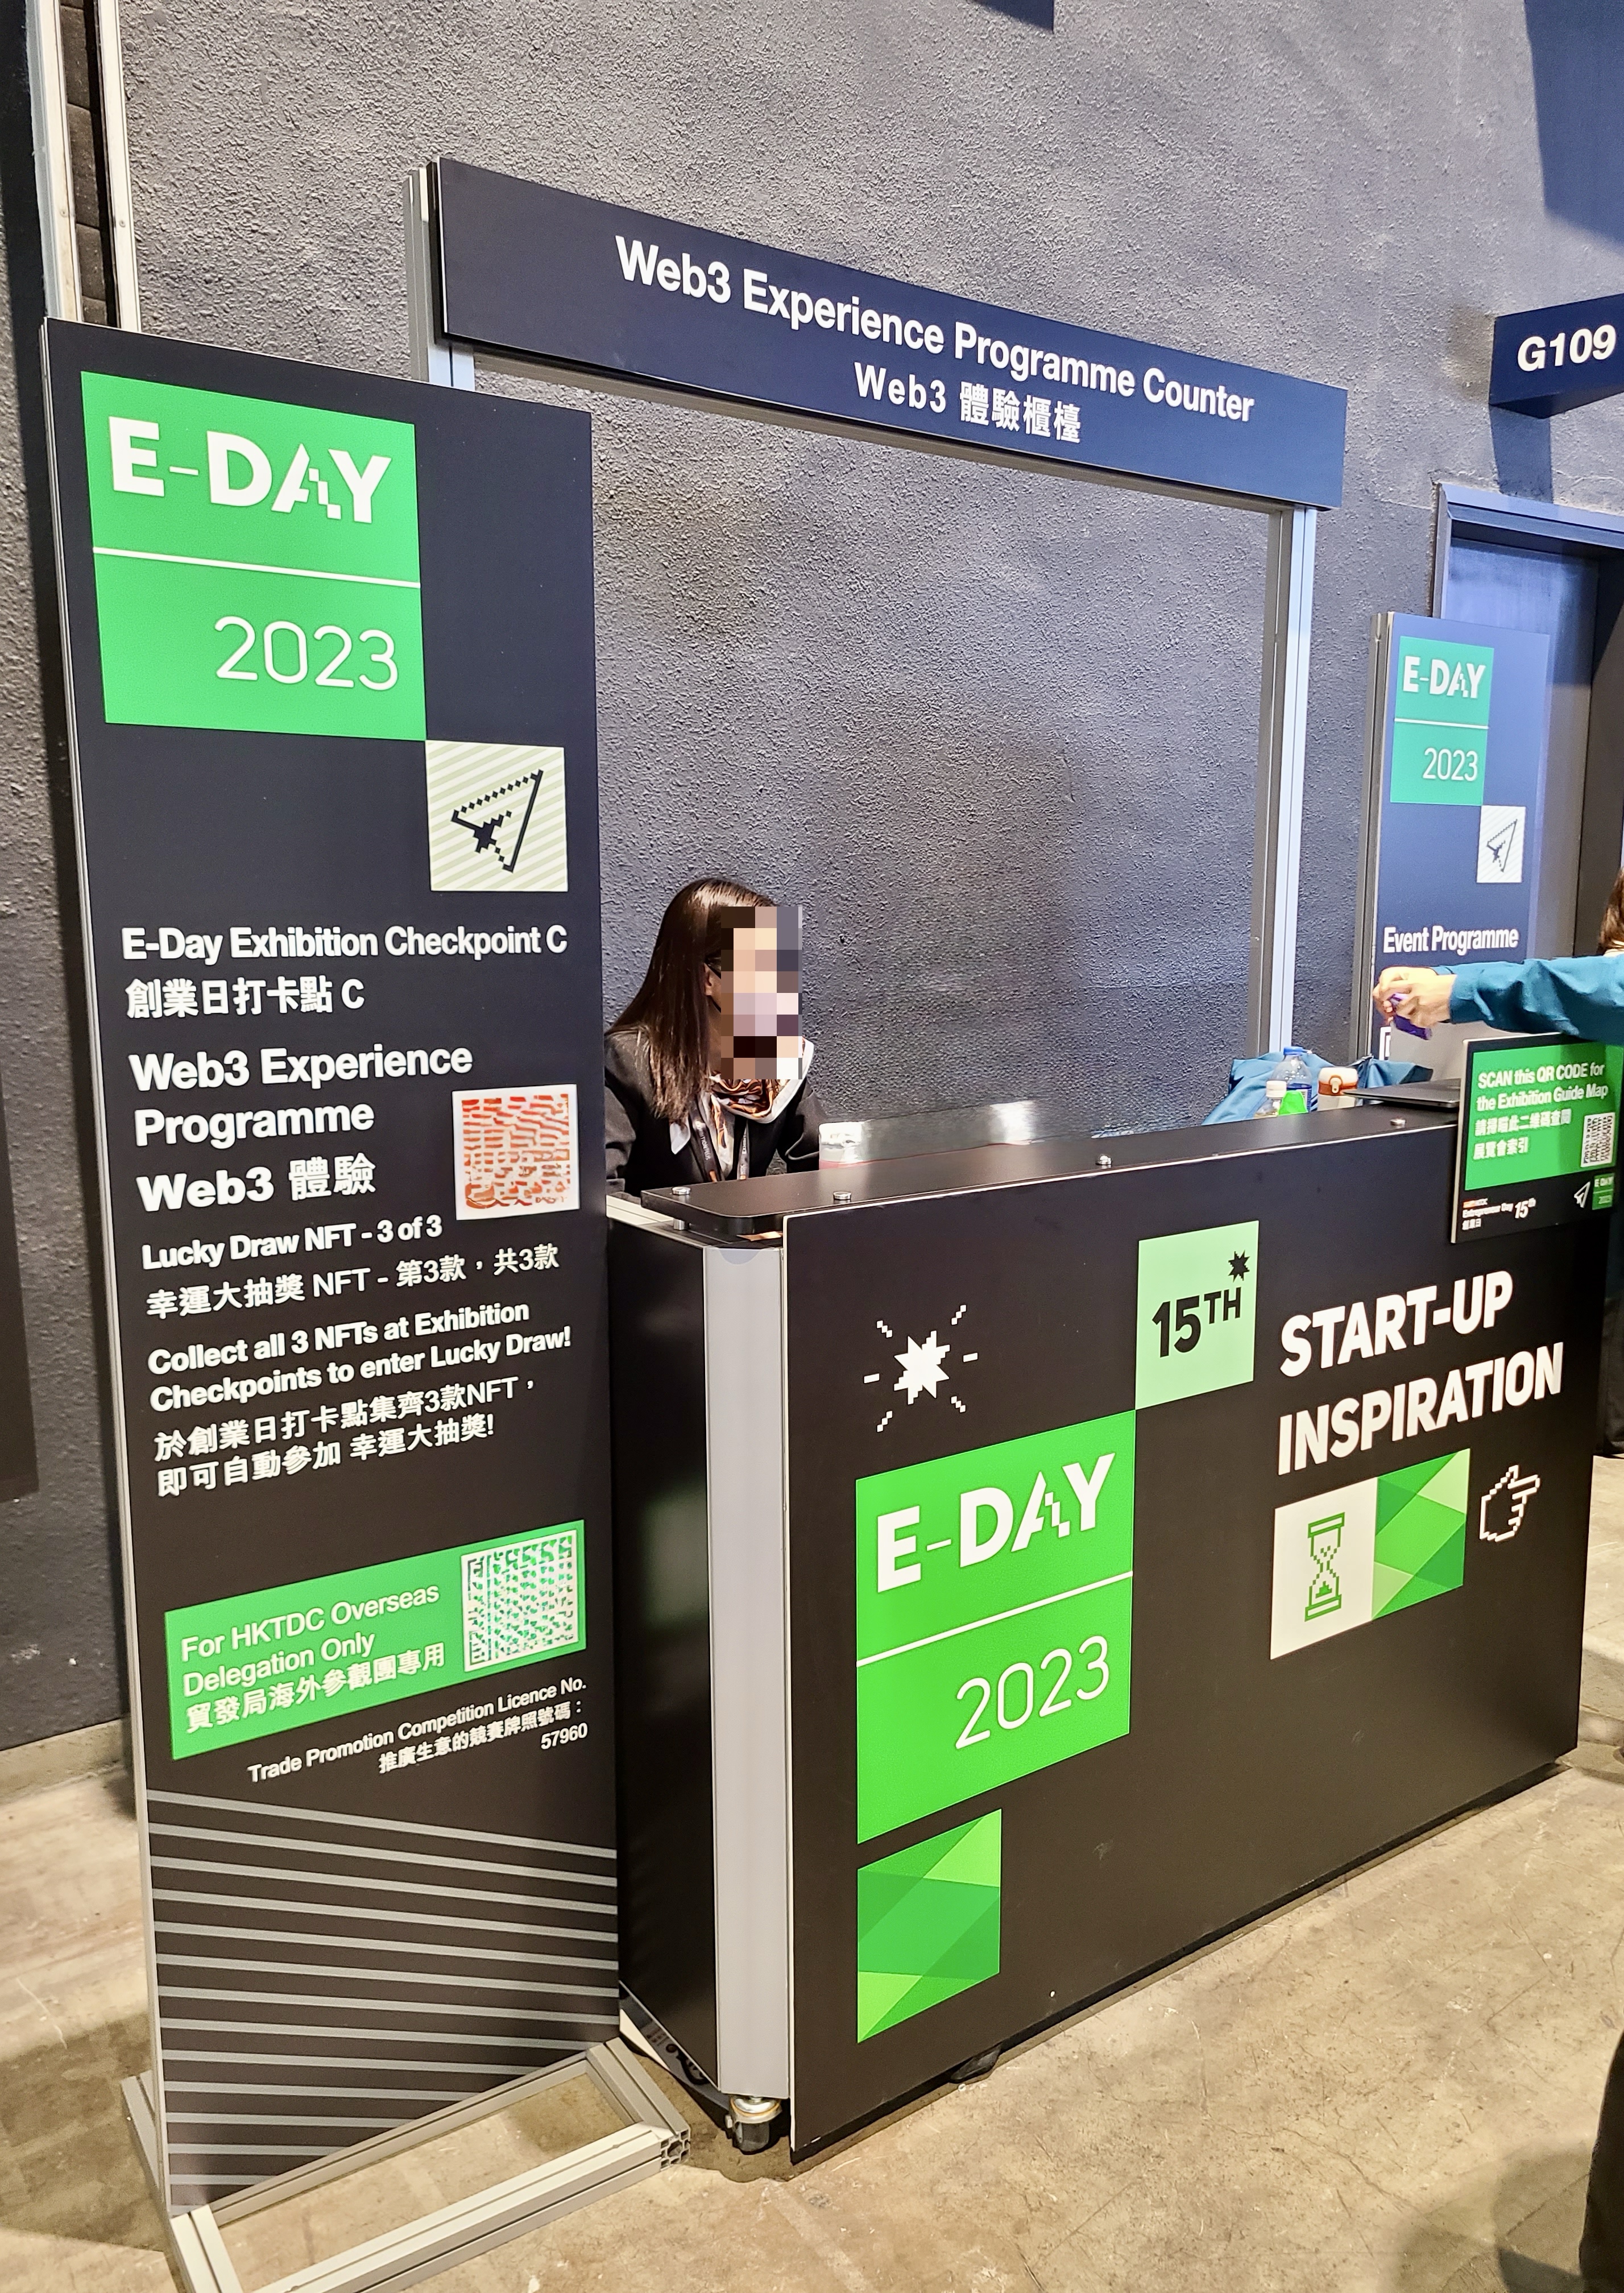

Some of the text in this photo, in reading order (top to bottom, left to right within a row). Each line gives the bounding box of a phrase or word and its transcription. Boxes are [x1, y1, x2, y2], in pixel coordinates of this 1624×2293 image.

[615, 235, 1254, 421] Web3 Experience Programme Counter
[1518, 325, 1615, 371] G109
[855, 362, 1080, 443] Web3 體驗櫃檯
[110, 417, 391, 522] E-DAY
[216, 617, 397, 689] 2023
[1403, 656, 1485, 698] E-DAY
[1423, 748, 1477, 781] 2023
[122, 925, 567, 965] E-Day Exhibition Checkpoint C
[1383, 925, 1519, 955] Event Programme
[125, 975, 364, 1018] 創業日打卡點 C
[129, 1044, 473, 1091] Web3 Experience
[1476, 1084, 1608, 1111] the Exhibition Guide Map
[1478, 1063, 1604, 1088] SCAN this QR CODE for
[135, 1104, 374, 1149] Programme
[136, 1153, 375, 1211] Web3 體驗
[142, 1240, 225, 1269] Lucky
[230, 1235, 299, 1259] Draw
[305, 1223, 356, 1251] NFT
[378, 1220, 393, 1242] 3
[398, 1216, 422, 1240] of
[426, 1215, 442, 1237] 3
[147, 1274, 305, 1319] 幸運大抽獎
[313, 1268, 370, 1297] NFT
[1153, 1288, 1241, 1357] 15TH
[1281, 1271, 1512, 1376] START-UP
[148, 1303, 529, 1374] Collect all 3 NFTs at Exhibition
[151, 1326, 570, 1411] Checkpoints to enter Lucky Draw!
[1279, 1342, 1563, 1475] INSPIRATION
[158, 1441, 340, 1496] 即可自動參加
[878, 1454, 1114, 1592] E-DAY
[182, 1586, 438, 1661] For HKTDC Overseas
[184, 1633, 374, 1696] Delegation Only
[187, 1643, 444, 1733] 貿發局海外參觀團專用
[956, 1636, 1108, 1748] 2023
[247, 1678, 586, 1782] Trade Promotion Competition Licence No.
[541, 1723, 587, 1749] 57960
